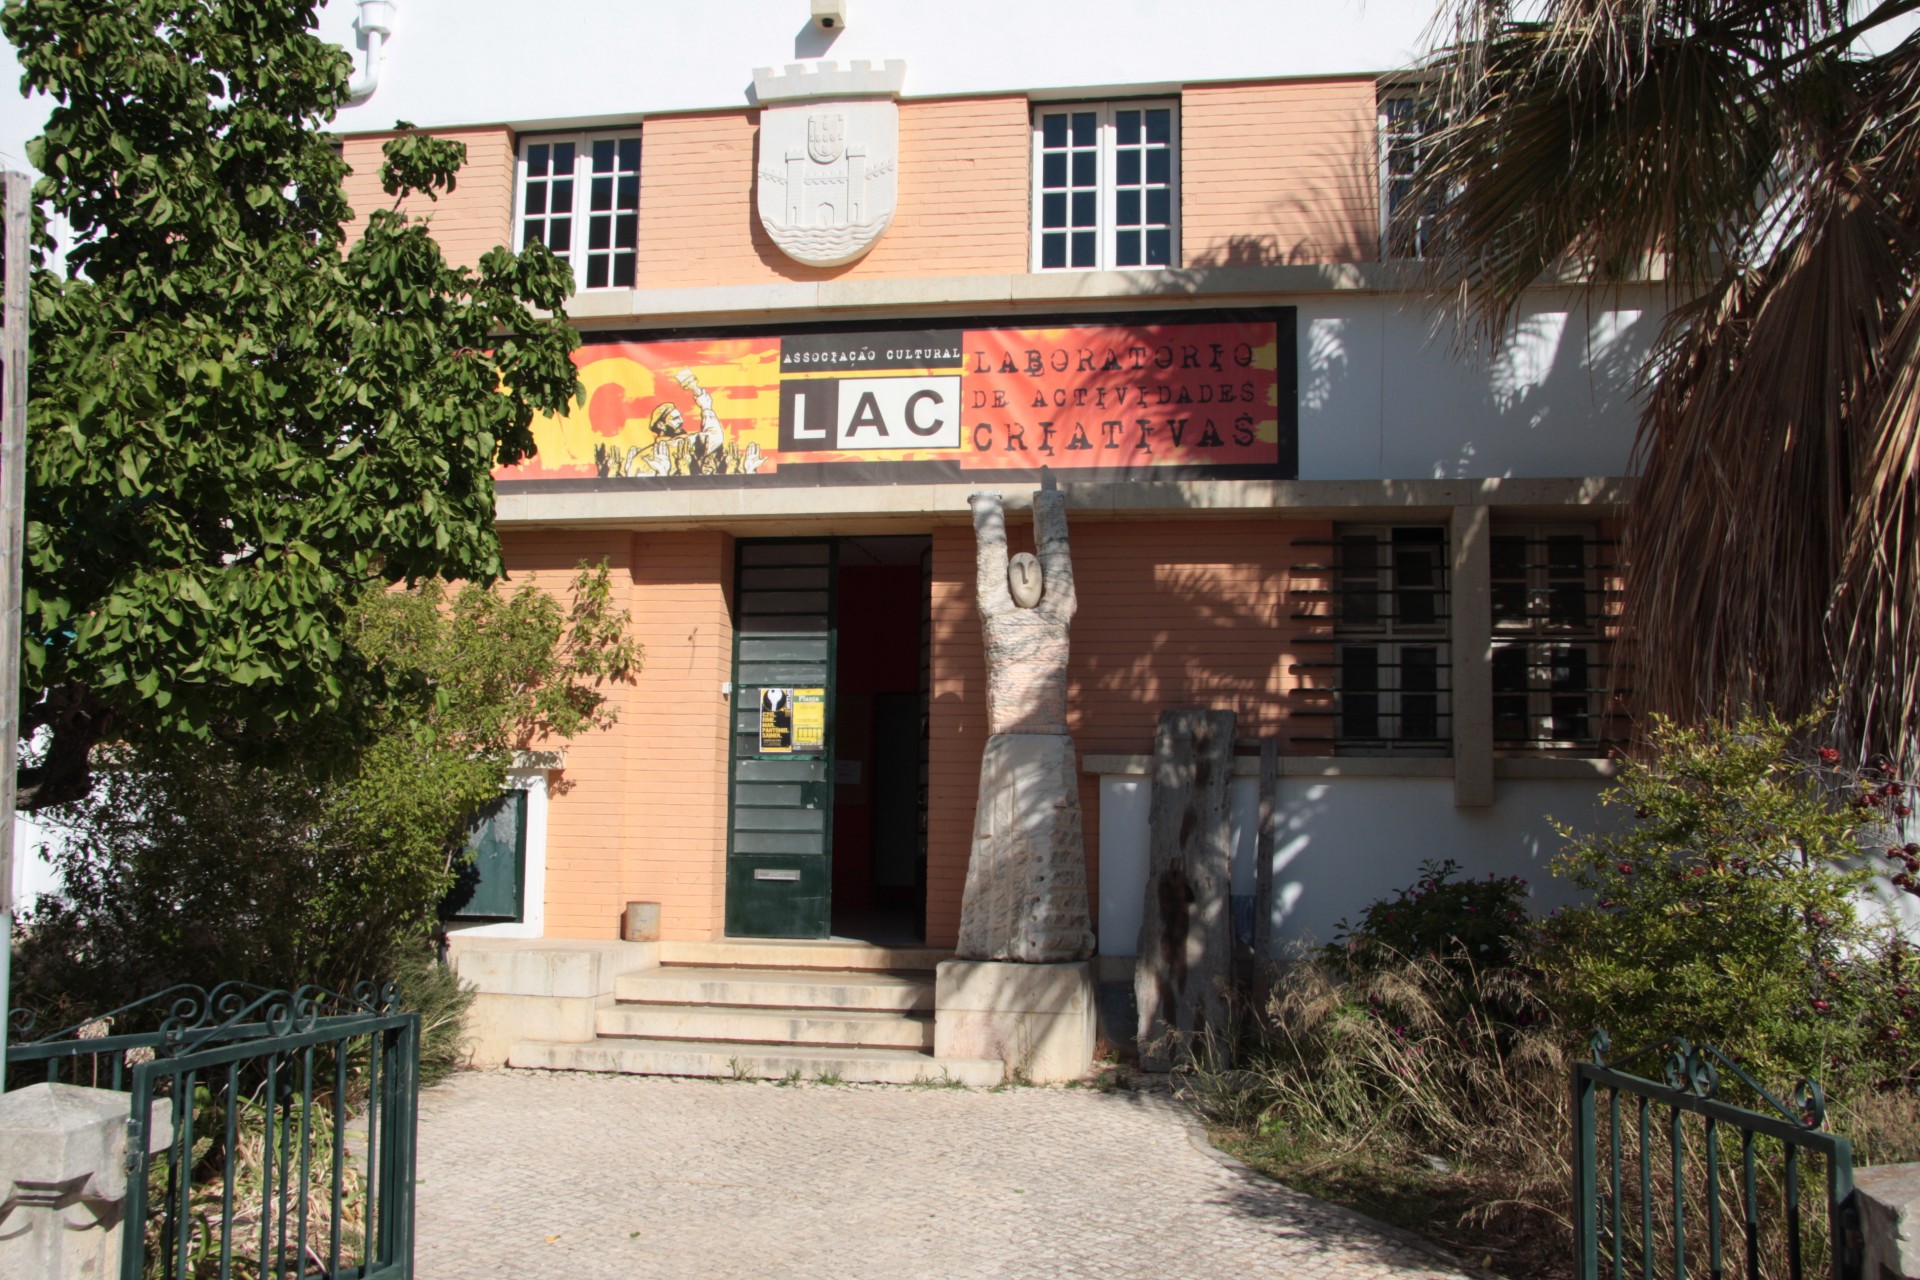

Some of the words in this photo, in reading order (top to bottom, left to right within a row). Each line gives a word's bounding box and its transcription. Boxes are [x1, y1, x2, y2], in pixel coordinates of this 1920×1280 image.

[783, 346, 876, 367] ASSOCIAÇÃO
[886, 348, 961, 361] CULTURAL
[974, 338, 1255, 377] LABORATÓRIO
[793, 389, 944, 440] LAC
[972, 390, 1009, 409] DE
[1031, 383, 1256, 409] ACTIVIDADES
[974, 412, 1256, 456] CRIATIVAS
